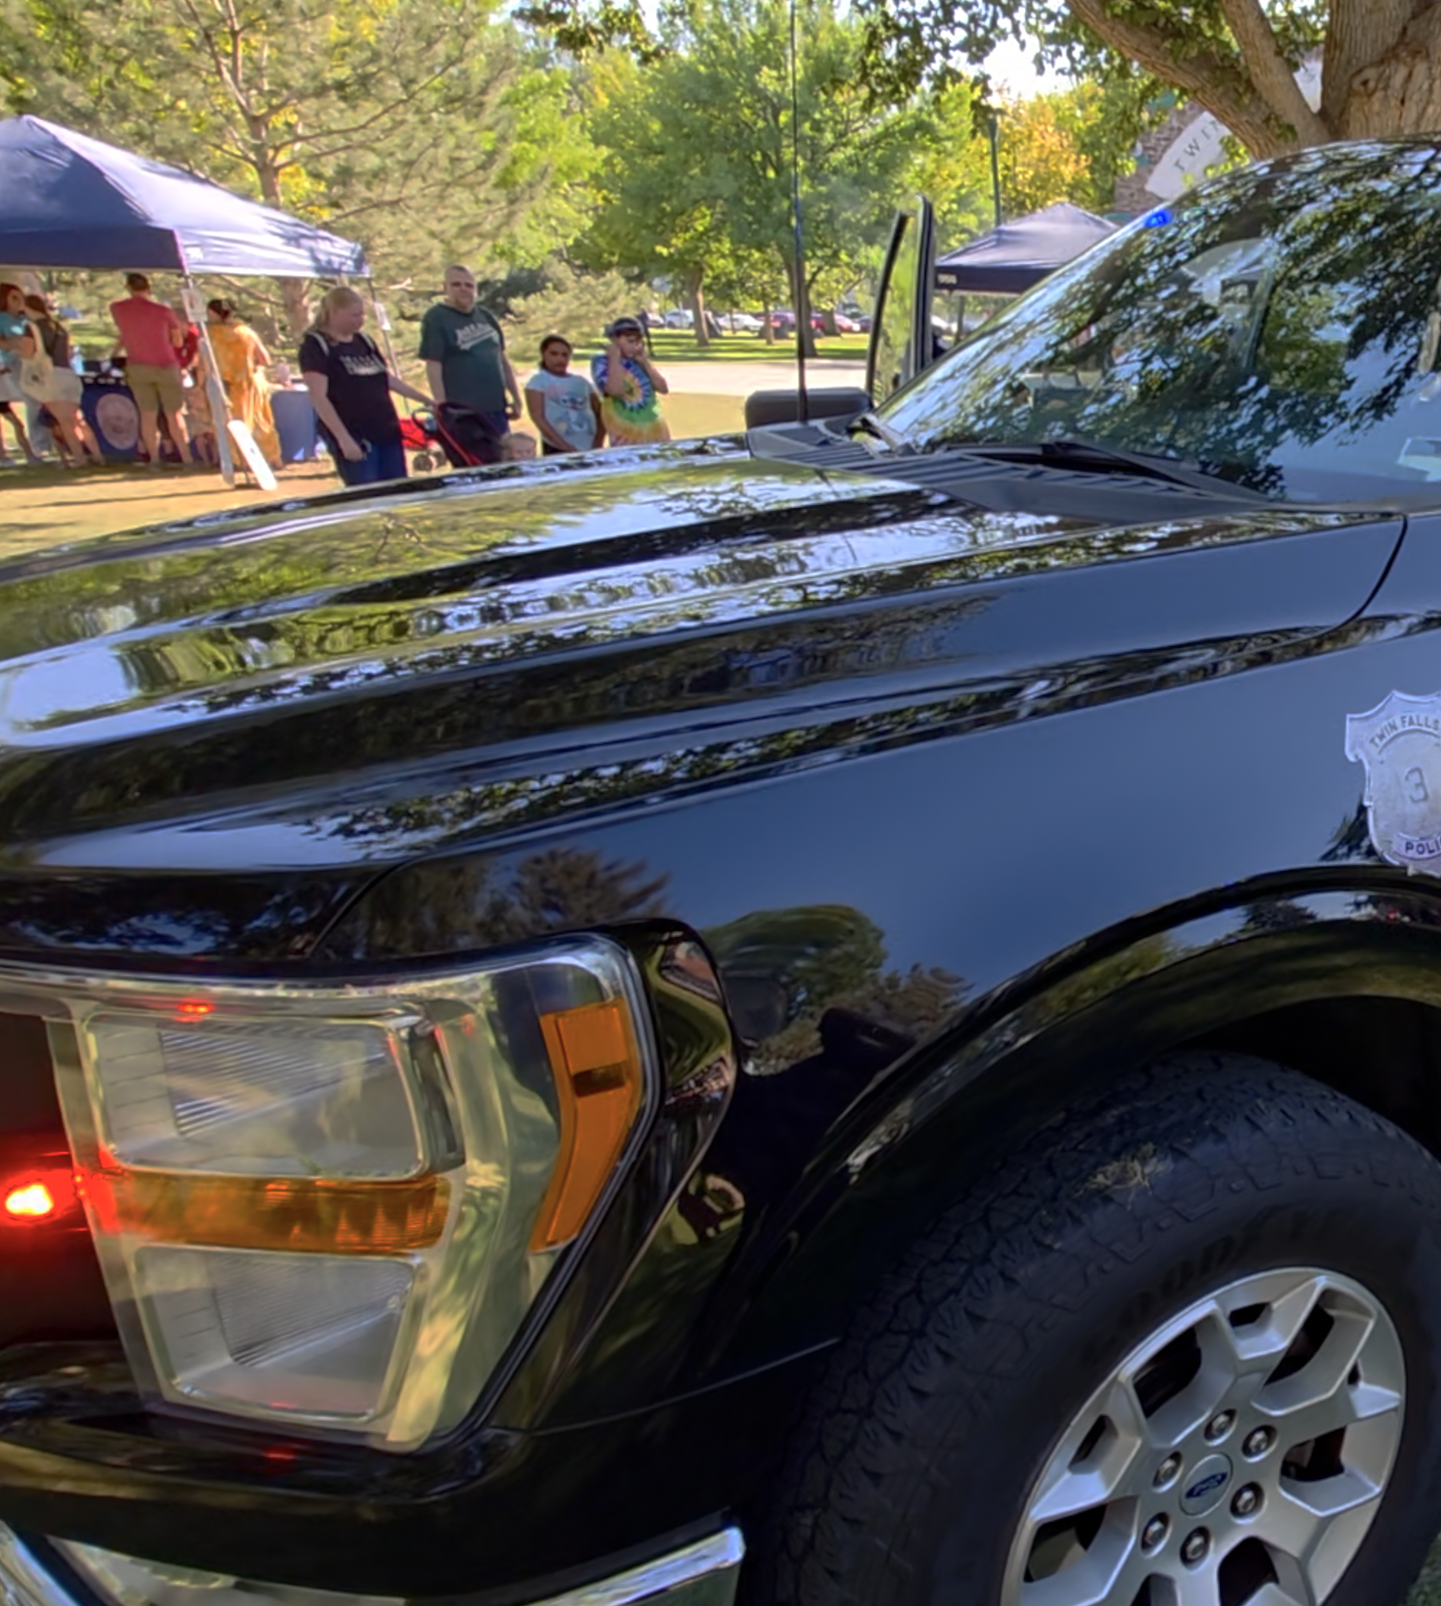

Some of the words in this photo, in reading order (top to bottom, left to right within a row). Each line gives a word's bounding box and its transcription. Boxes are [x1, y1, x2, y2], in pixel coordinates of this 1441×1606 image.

[1369, 718, 1398, 748] TWIN
[1400, 715, 1440, 731] FALLS
[1405, 766, 1429, 803] 3
